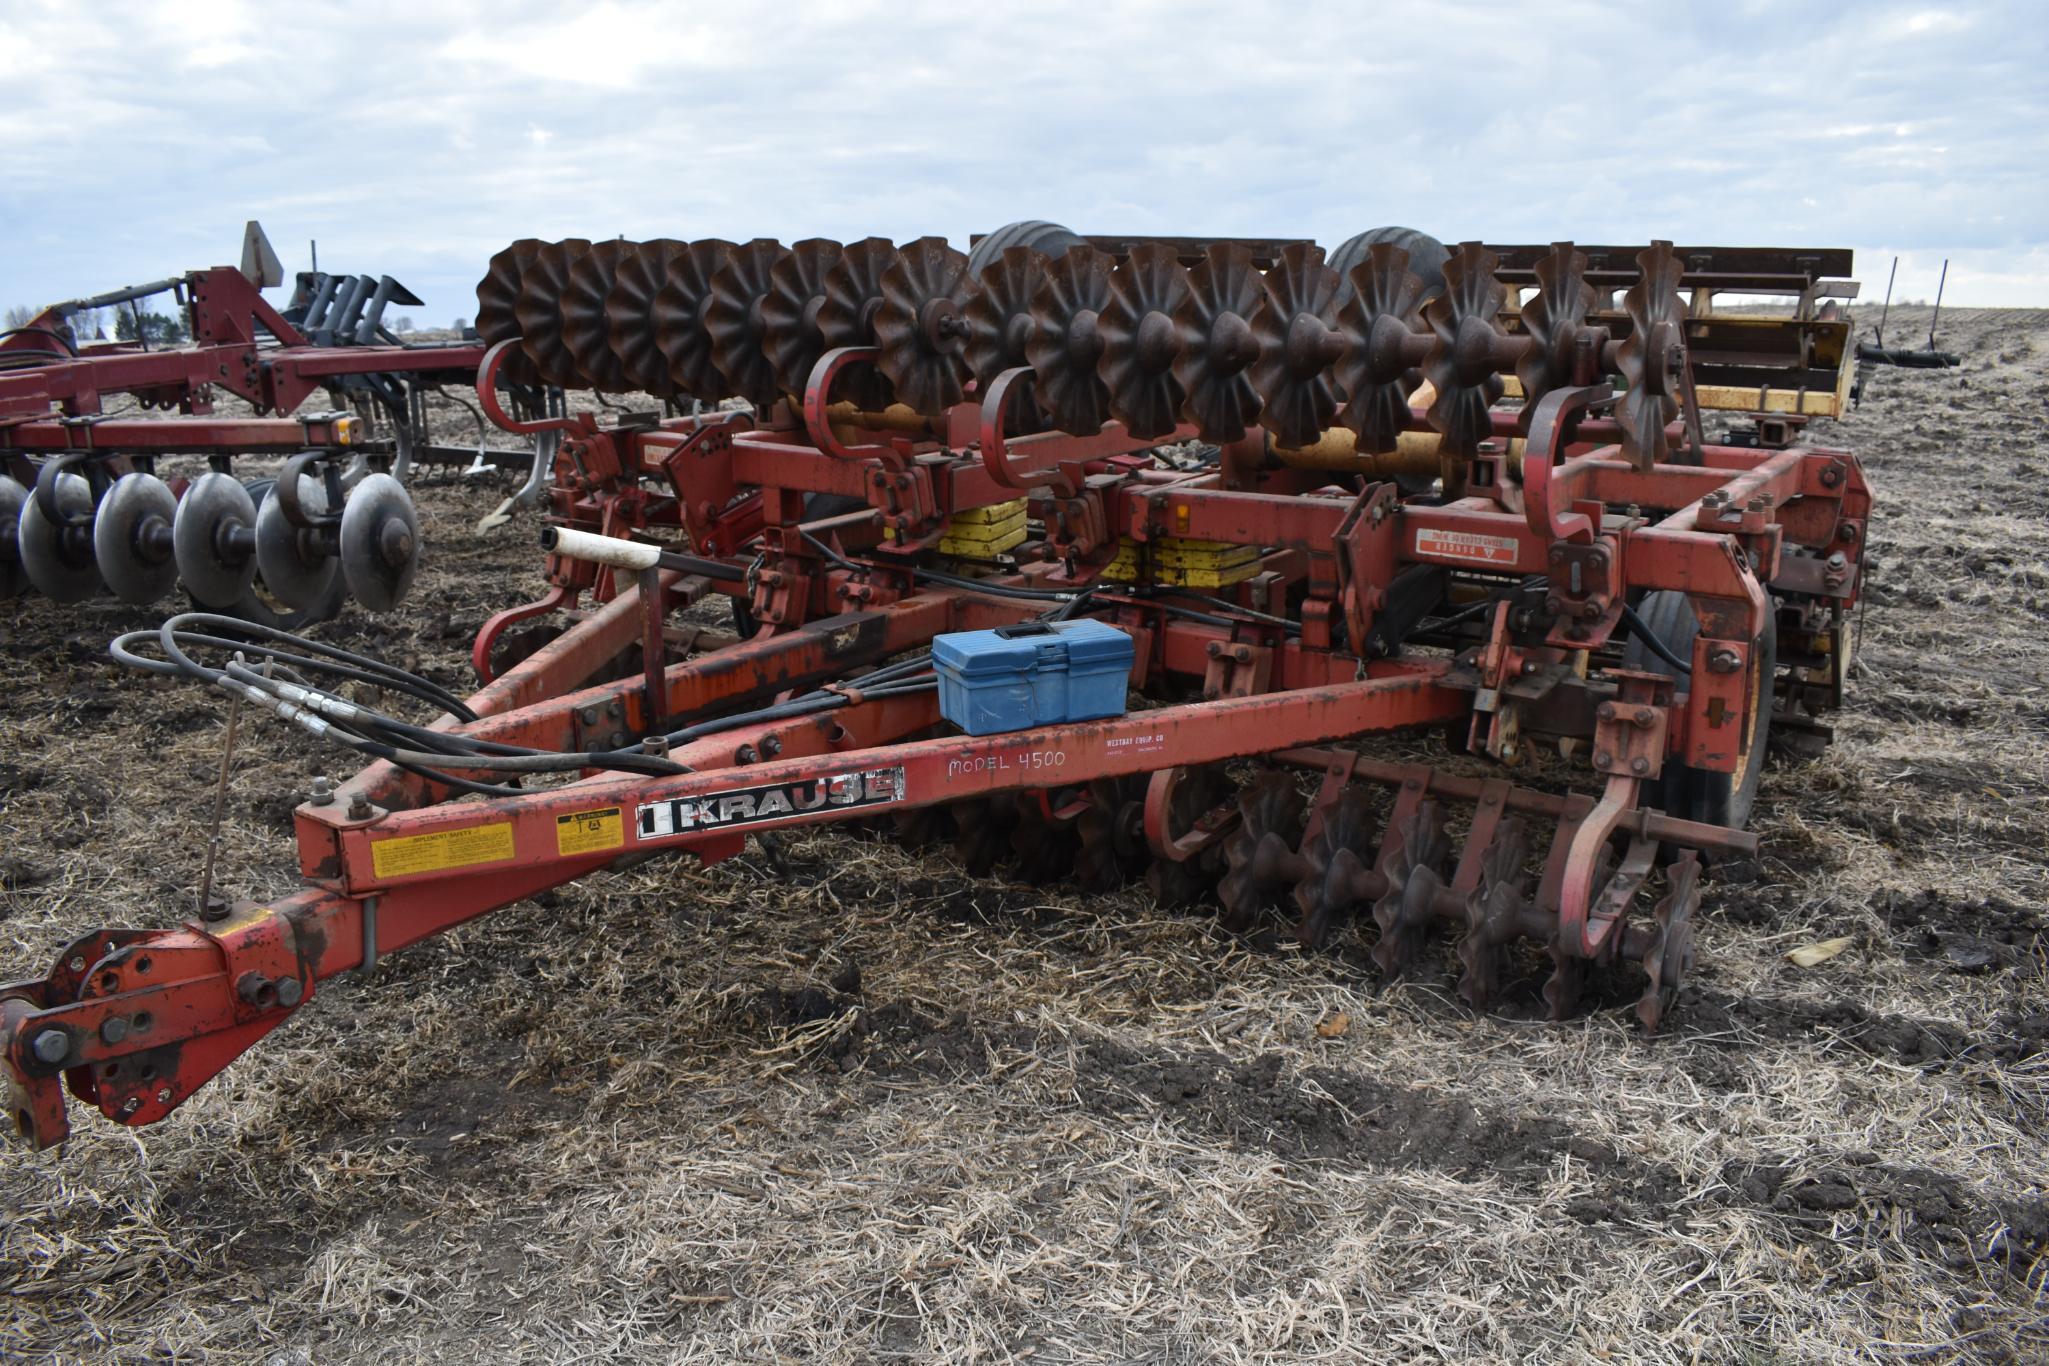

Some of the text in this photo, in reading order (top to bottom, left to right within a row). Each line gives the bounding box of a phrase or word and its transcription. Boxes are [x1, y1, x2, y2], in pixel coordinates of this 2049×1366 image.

[1435, 542, 1475, 554] DANGER
[949, 751, 1066, 777] MODEL 4500
[680, 775, 897, 829] KRAUSE
